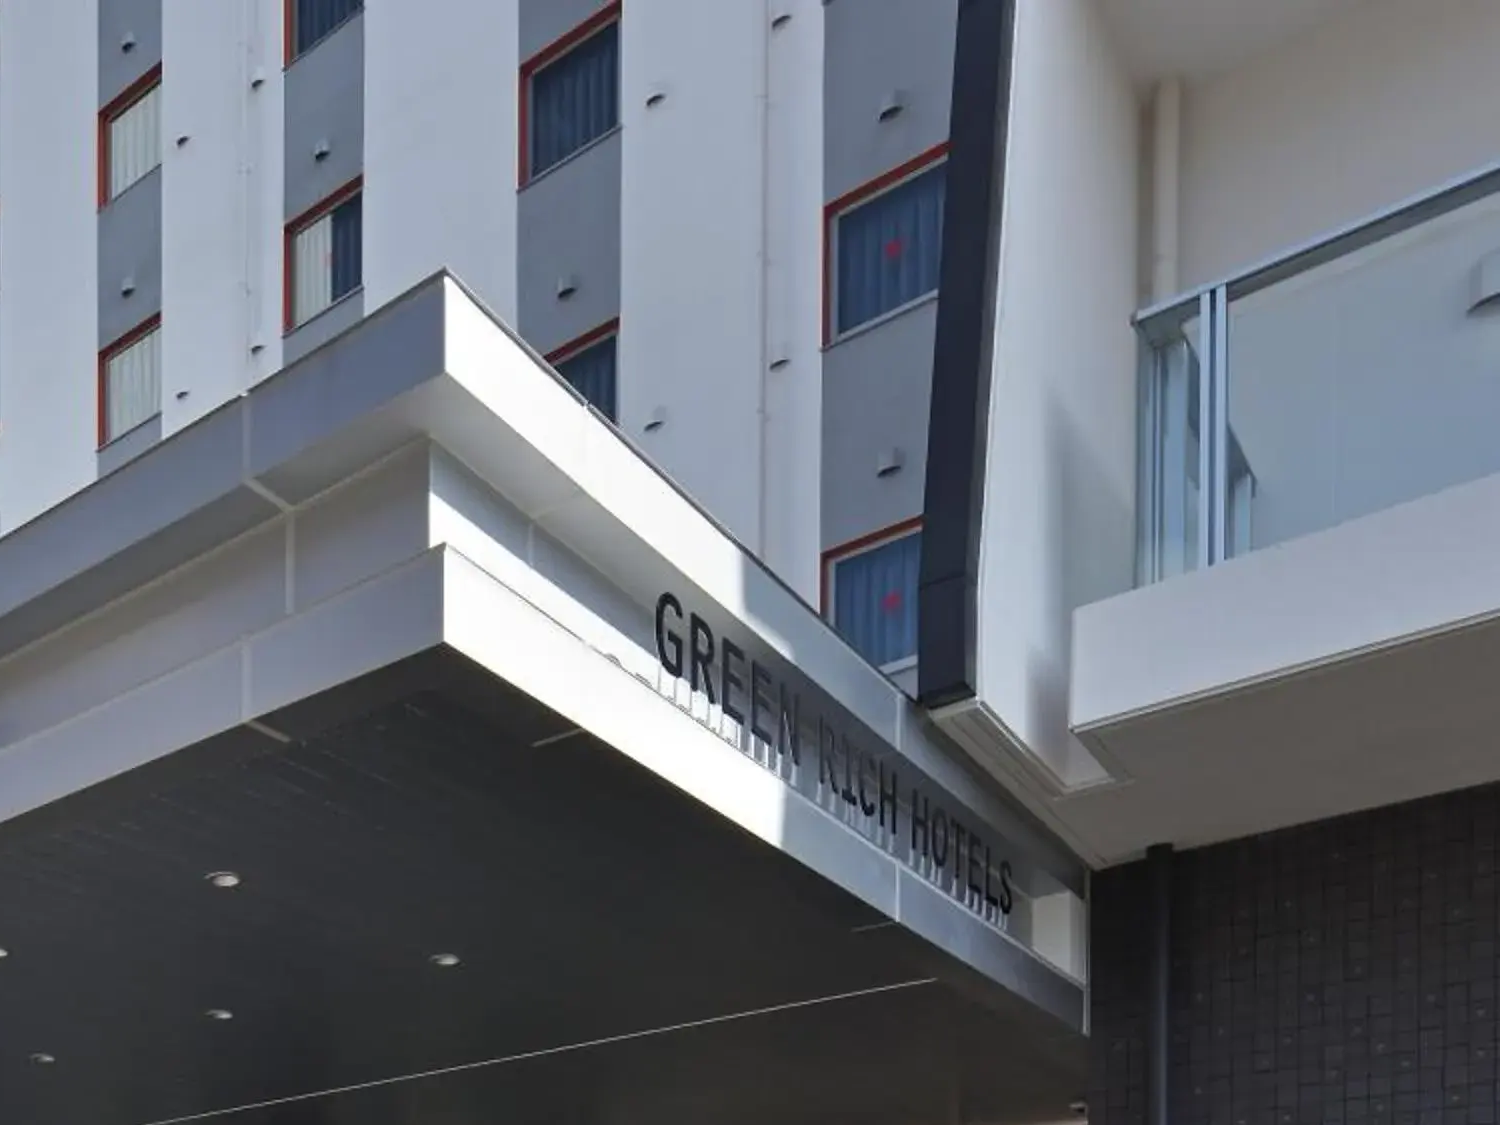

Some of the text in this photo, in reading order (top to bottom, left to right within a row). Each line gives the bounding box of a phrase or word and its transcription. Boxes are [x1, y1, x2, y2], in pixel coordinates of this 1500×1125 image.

[655, 592, 1012, 915] GREEN RICH HOTELS
